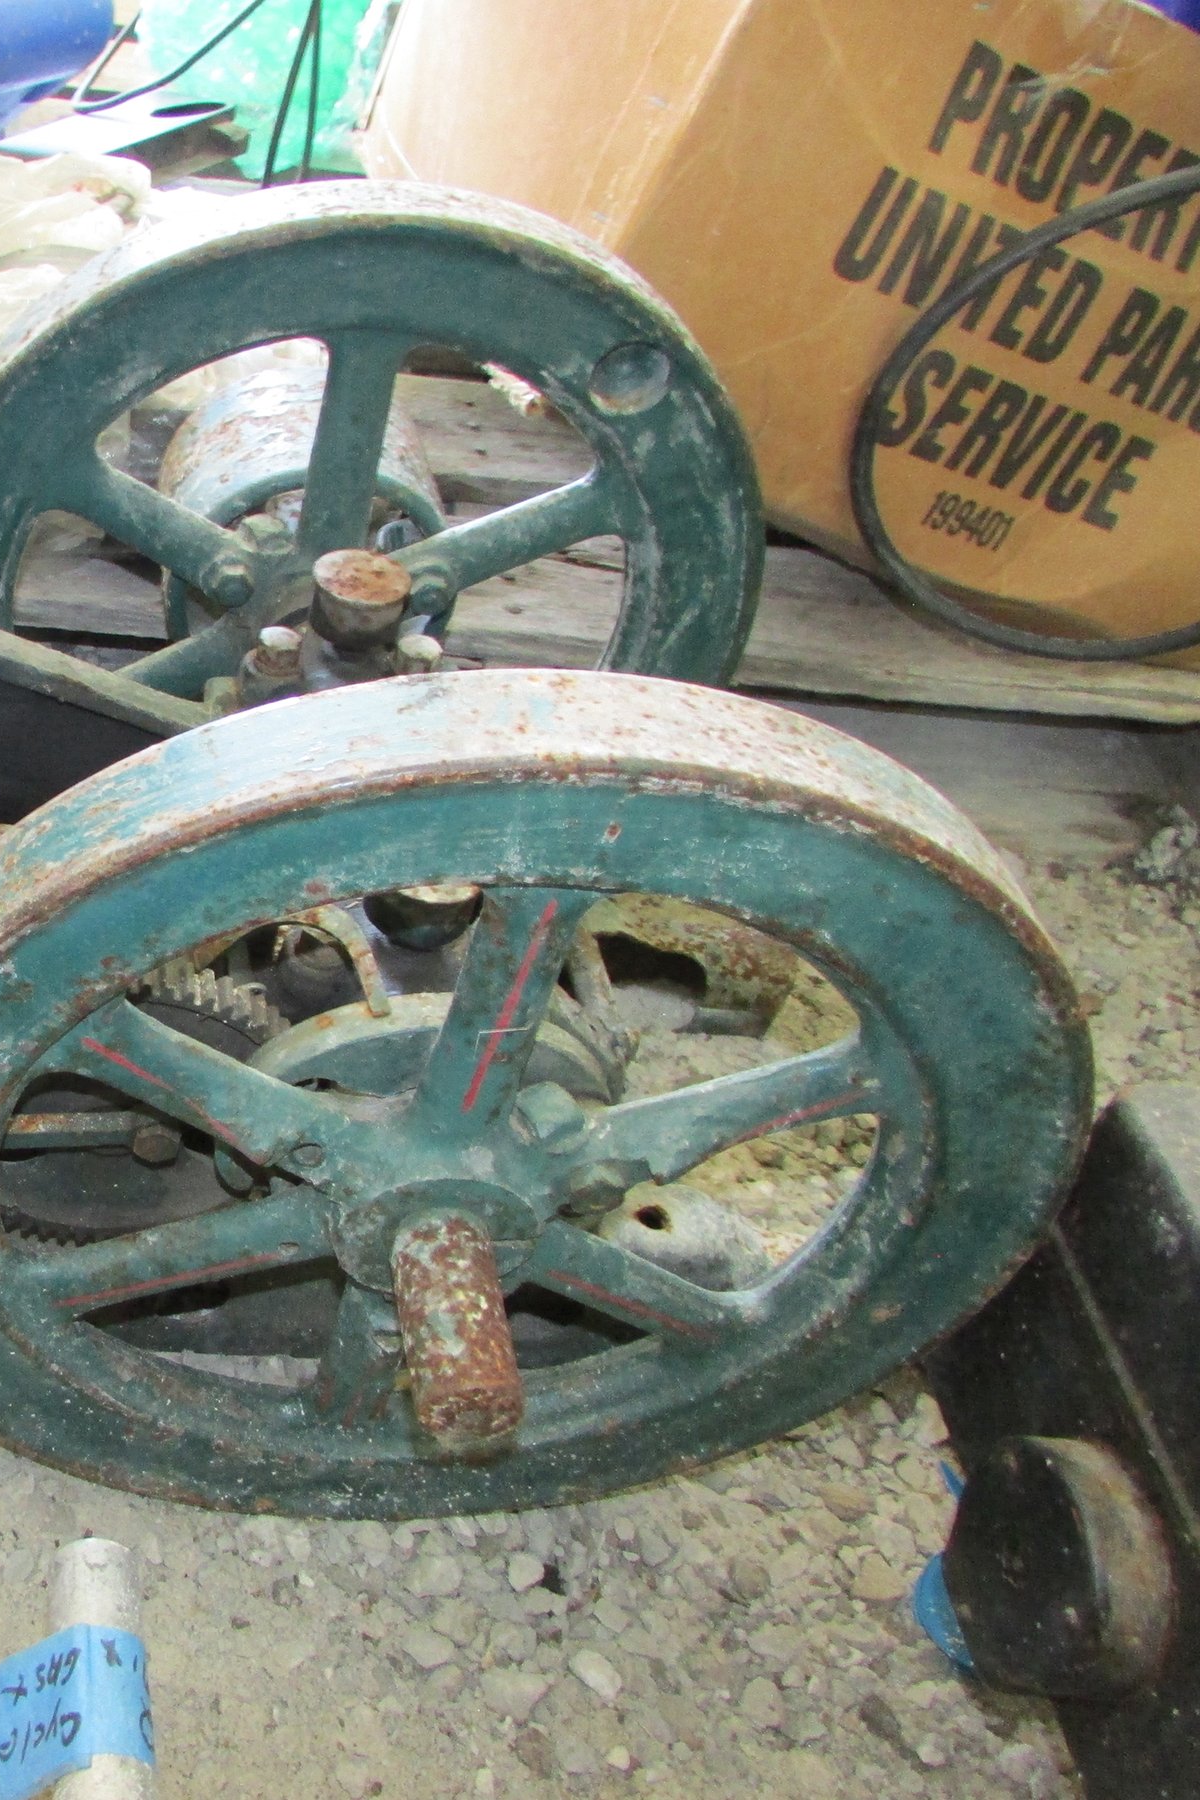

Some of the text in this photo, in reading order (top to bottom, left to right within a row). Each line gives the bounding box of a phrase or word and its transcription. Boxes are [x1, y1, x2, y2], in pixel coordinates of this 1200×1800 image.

[833, 166, 1200, 433] UNITED PAR
[875, 349, 1156, 531] SERVICE
[921, 490, 1016, 552] 199401
[34, 1647, 82, 1694] GAS
